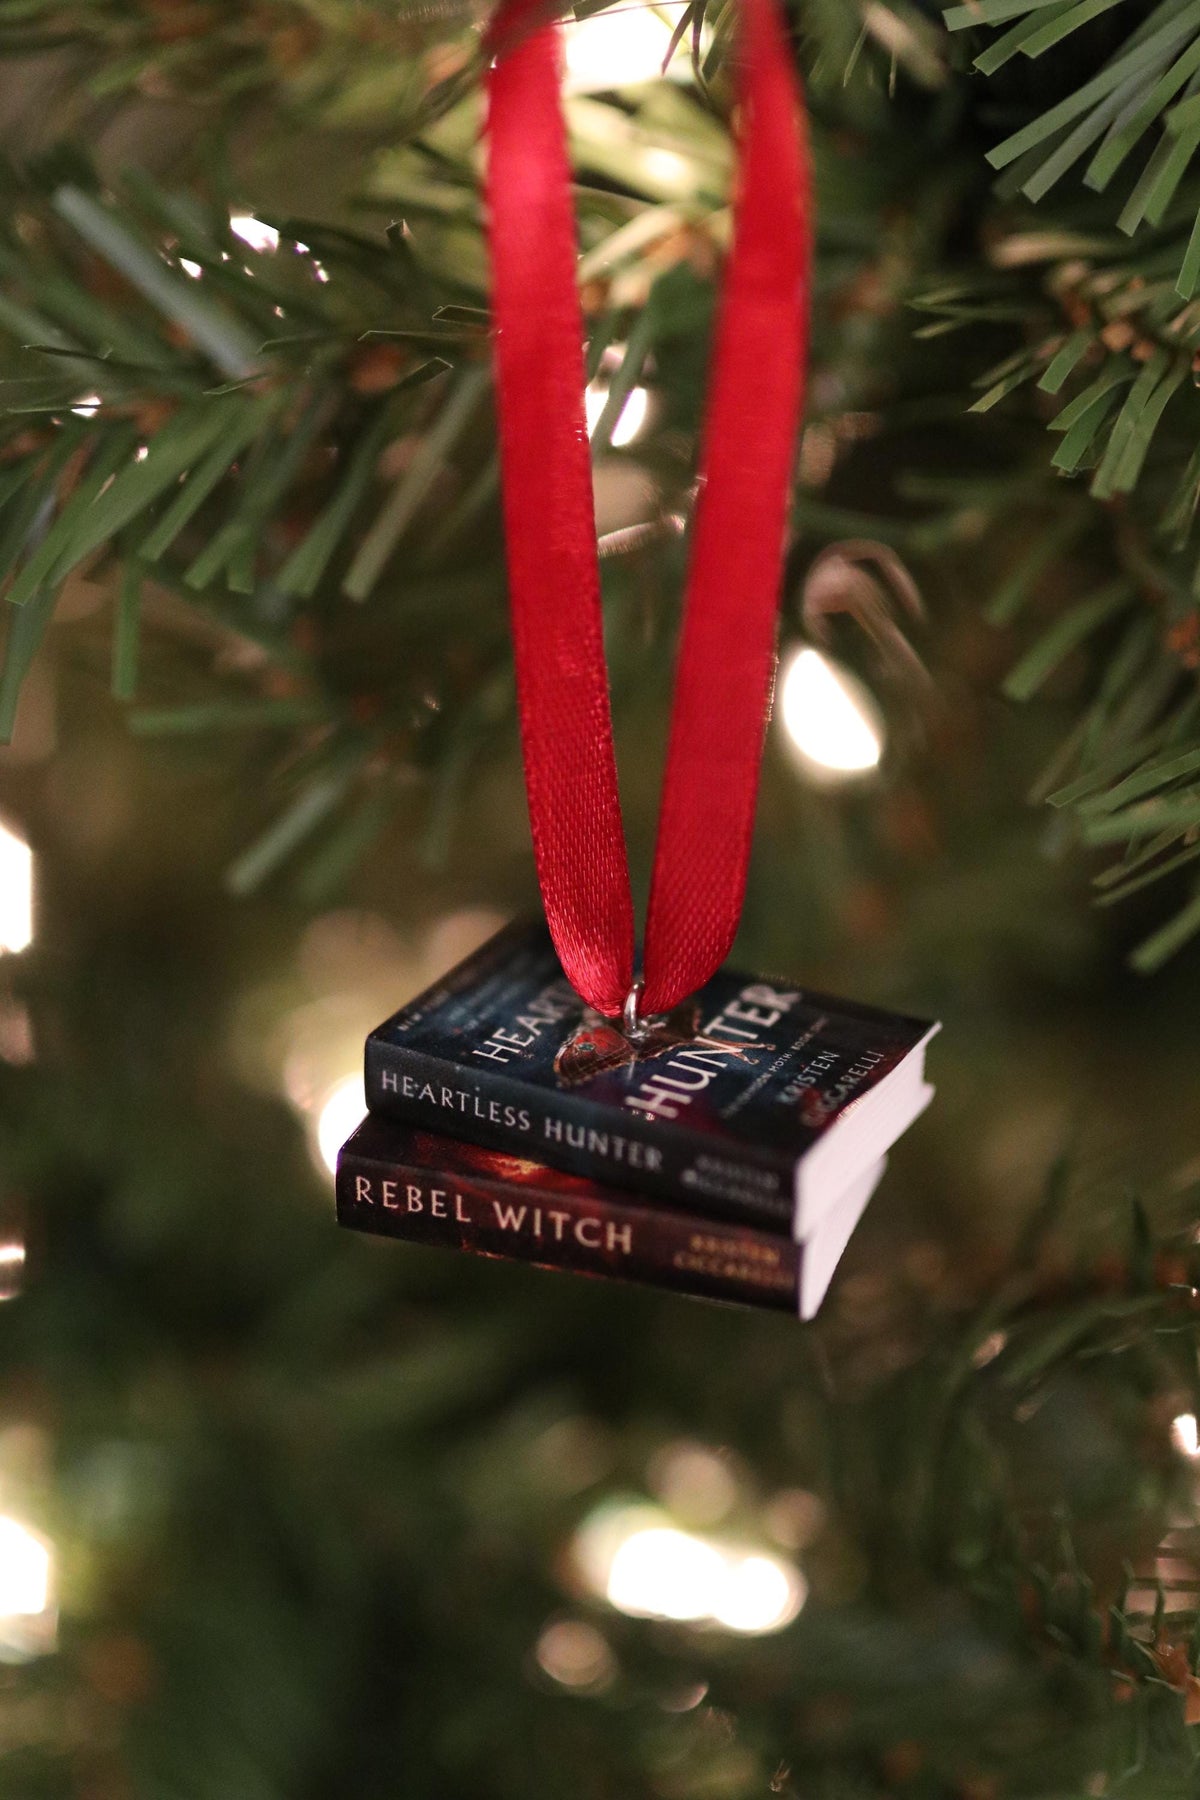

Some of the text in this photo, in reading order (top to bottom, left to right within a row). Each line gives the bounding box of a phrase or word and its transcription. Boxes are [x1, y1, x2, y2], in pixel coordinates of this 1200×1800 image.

[471, 982, 578, 1063] HEART
[625, 983, 801, 1119] HUNTER
[381, 1069, 663, 1172] HEARTLESS HUNTER
[355, 1174, 472, 1224] REBEL
[492, 1199, 633, 1255] WITCH
